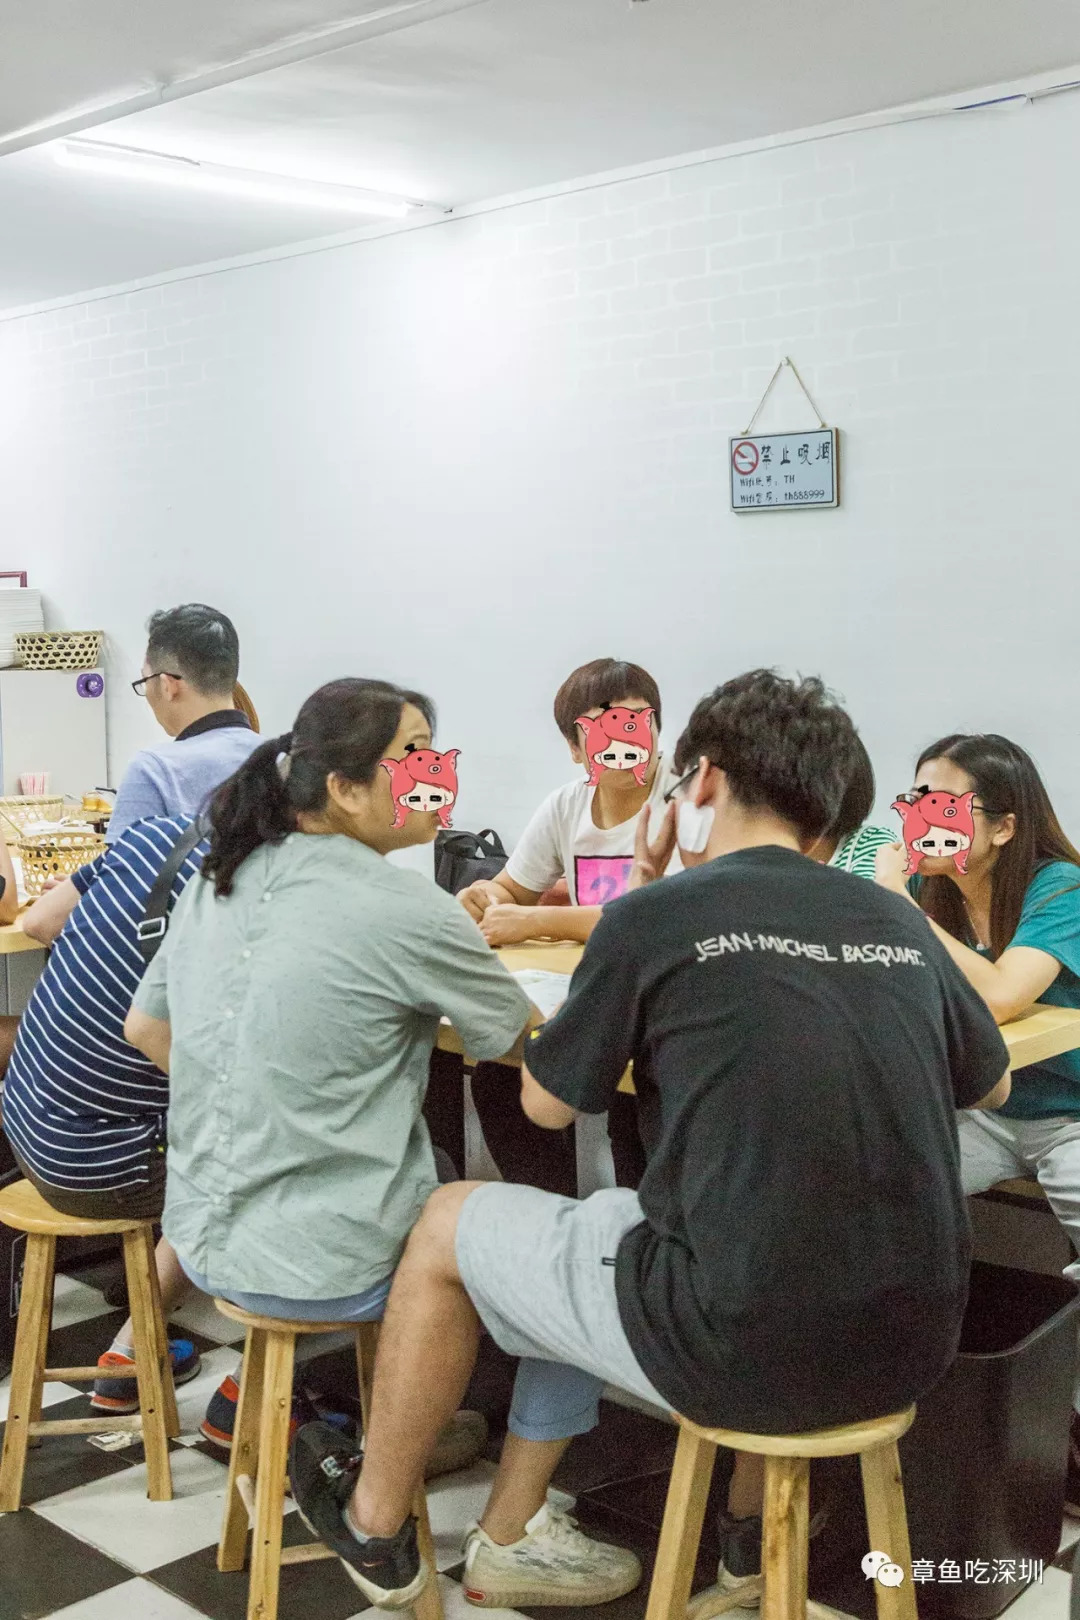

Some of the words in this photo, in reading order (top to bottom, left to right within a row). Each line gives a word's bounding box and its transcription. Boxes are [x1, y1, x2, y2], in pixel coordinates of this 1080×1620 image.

[761, 442, 831, 469] 禁止吸烟
[784, 475, 795, 484] TH
